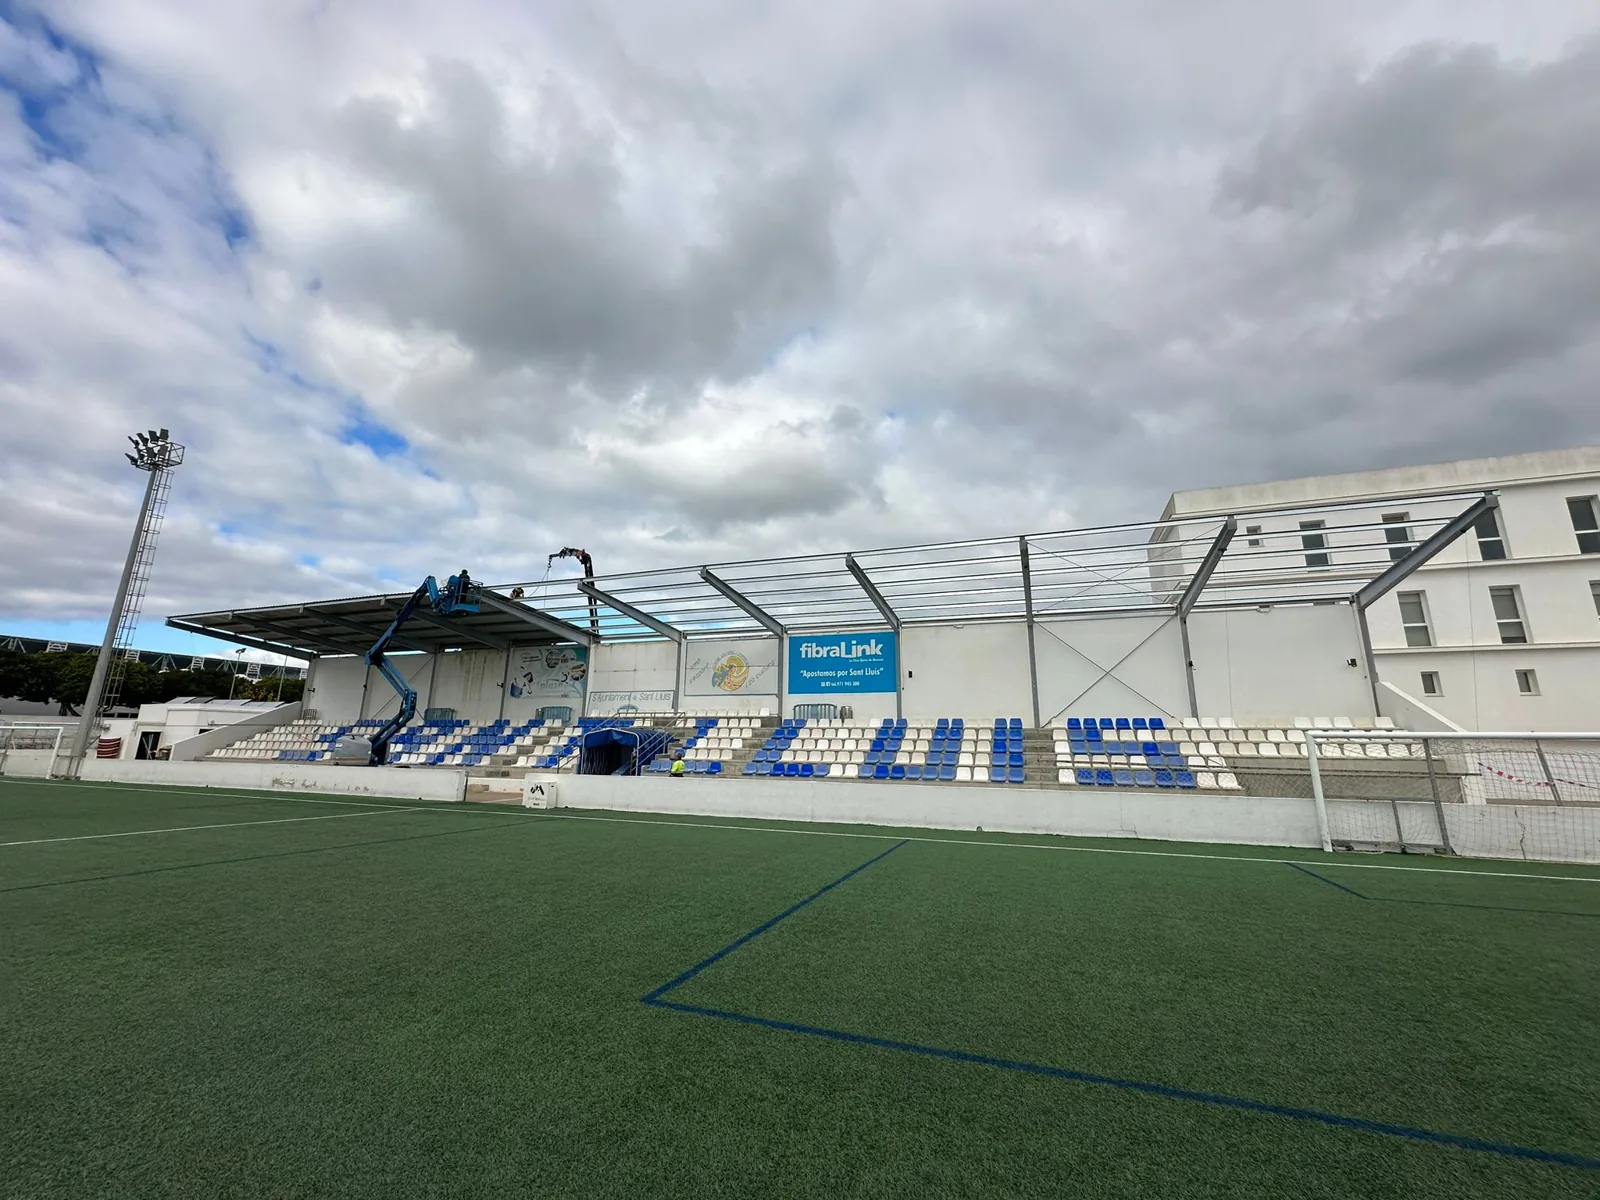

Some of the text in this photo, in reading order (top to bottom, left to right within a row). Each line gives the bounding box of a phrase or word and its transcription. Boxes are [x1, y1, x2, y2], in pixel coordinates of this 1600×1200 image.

[799, 639, 884, 658] fibraLink
[837, 670, 848, 678] por
[849, 668, 864, 676] Sant
